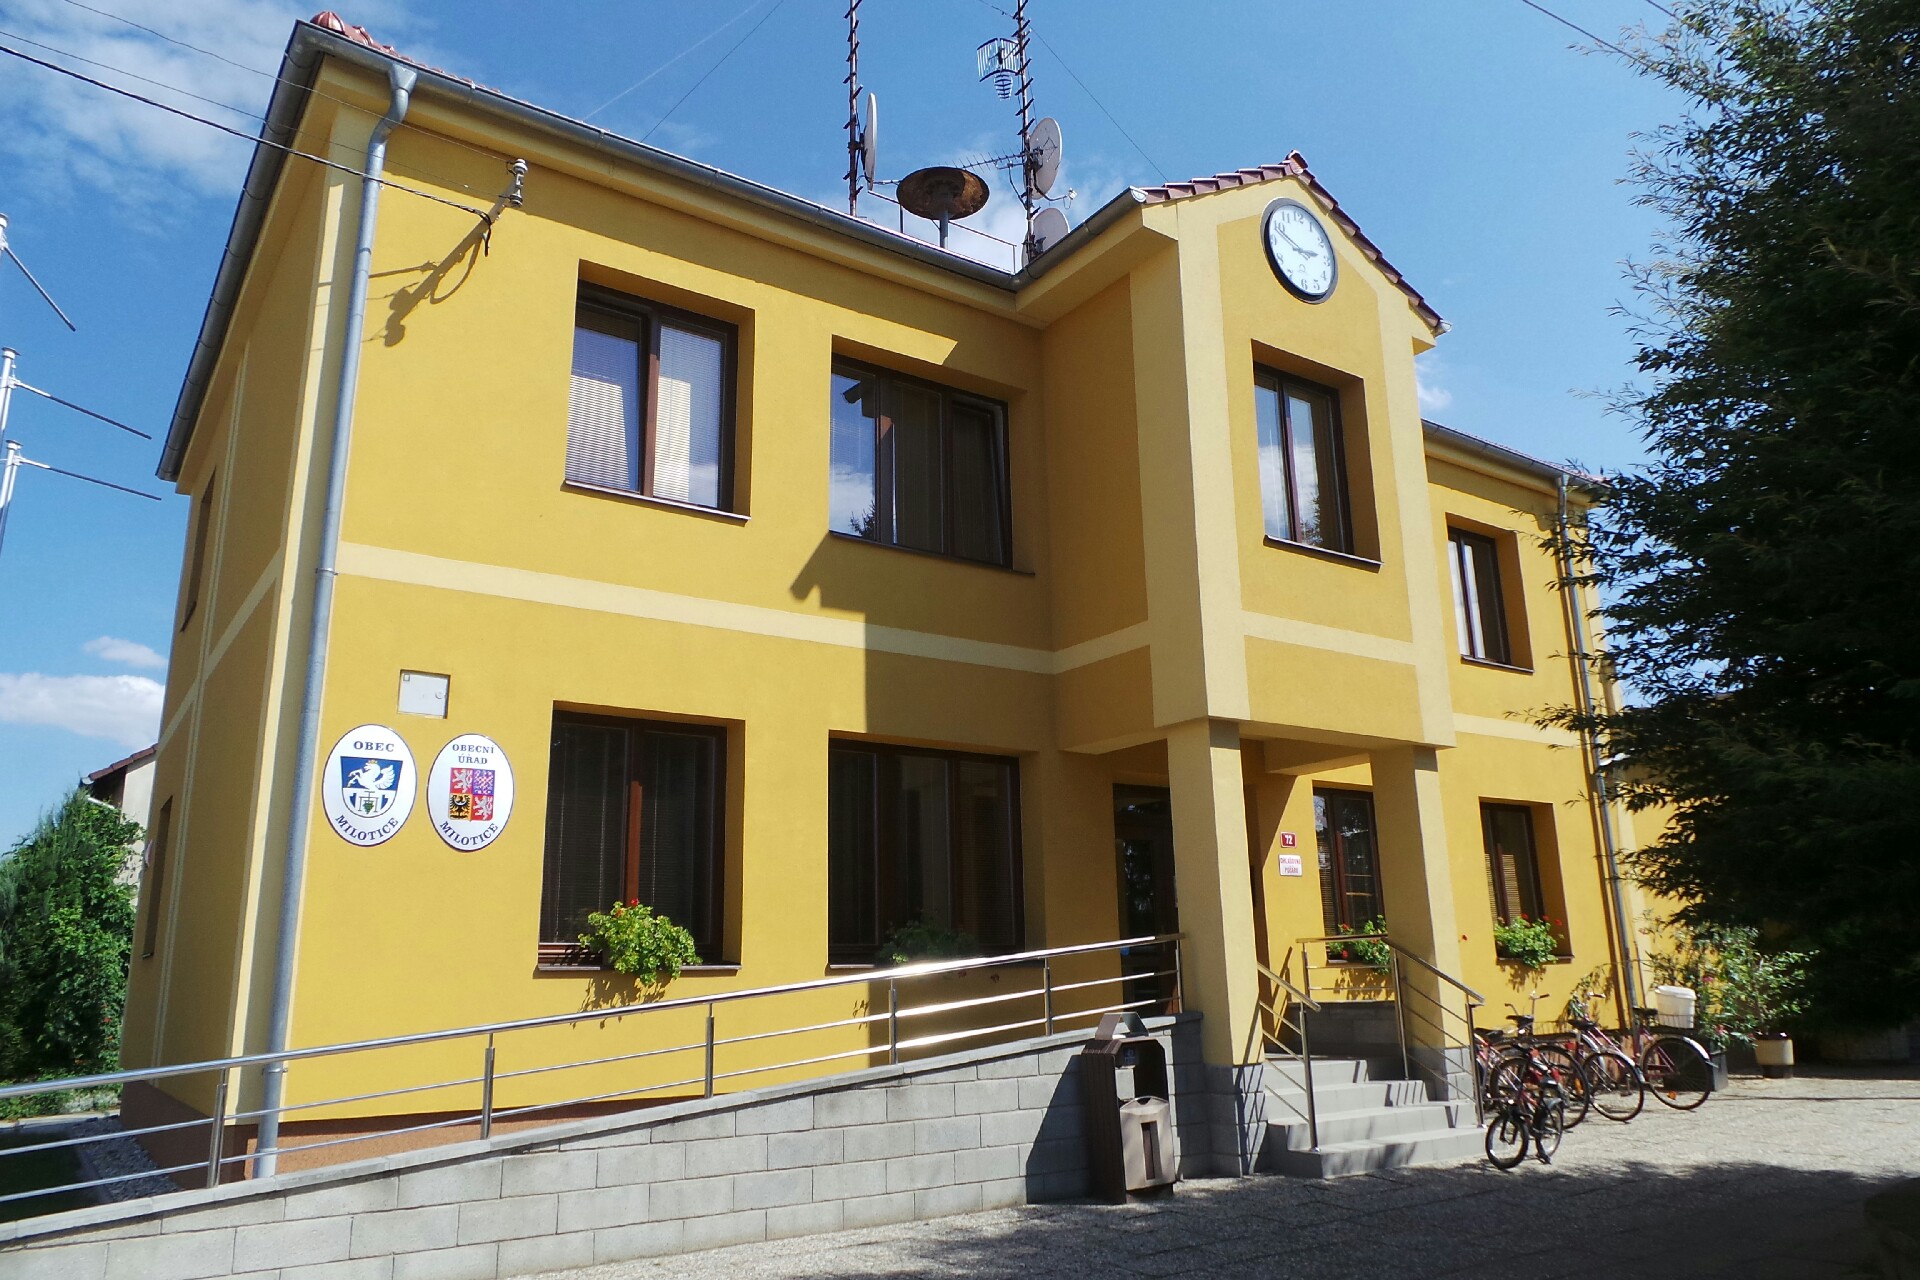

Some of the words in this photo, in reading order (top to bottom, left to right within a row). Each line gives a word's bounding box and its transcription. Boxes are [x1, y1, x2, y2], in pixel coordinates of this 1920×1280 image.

[1281, 211, 1290, 223] 11
[1293, 211, 1304, 224] 12
[1309, 221, 1313, 232] 1
[353, 740, 395, 752] OBEC
[452, 743, 495, 754] OBECNÍ
[458, 753, 488, 765] ÚŘAD
[335, 814, 399, 841] MILOTICE
[440, 820, 499, 846] MILOTICE
[1284, 834, 1293, 844] 72
